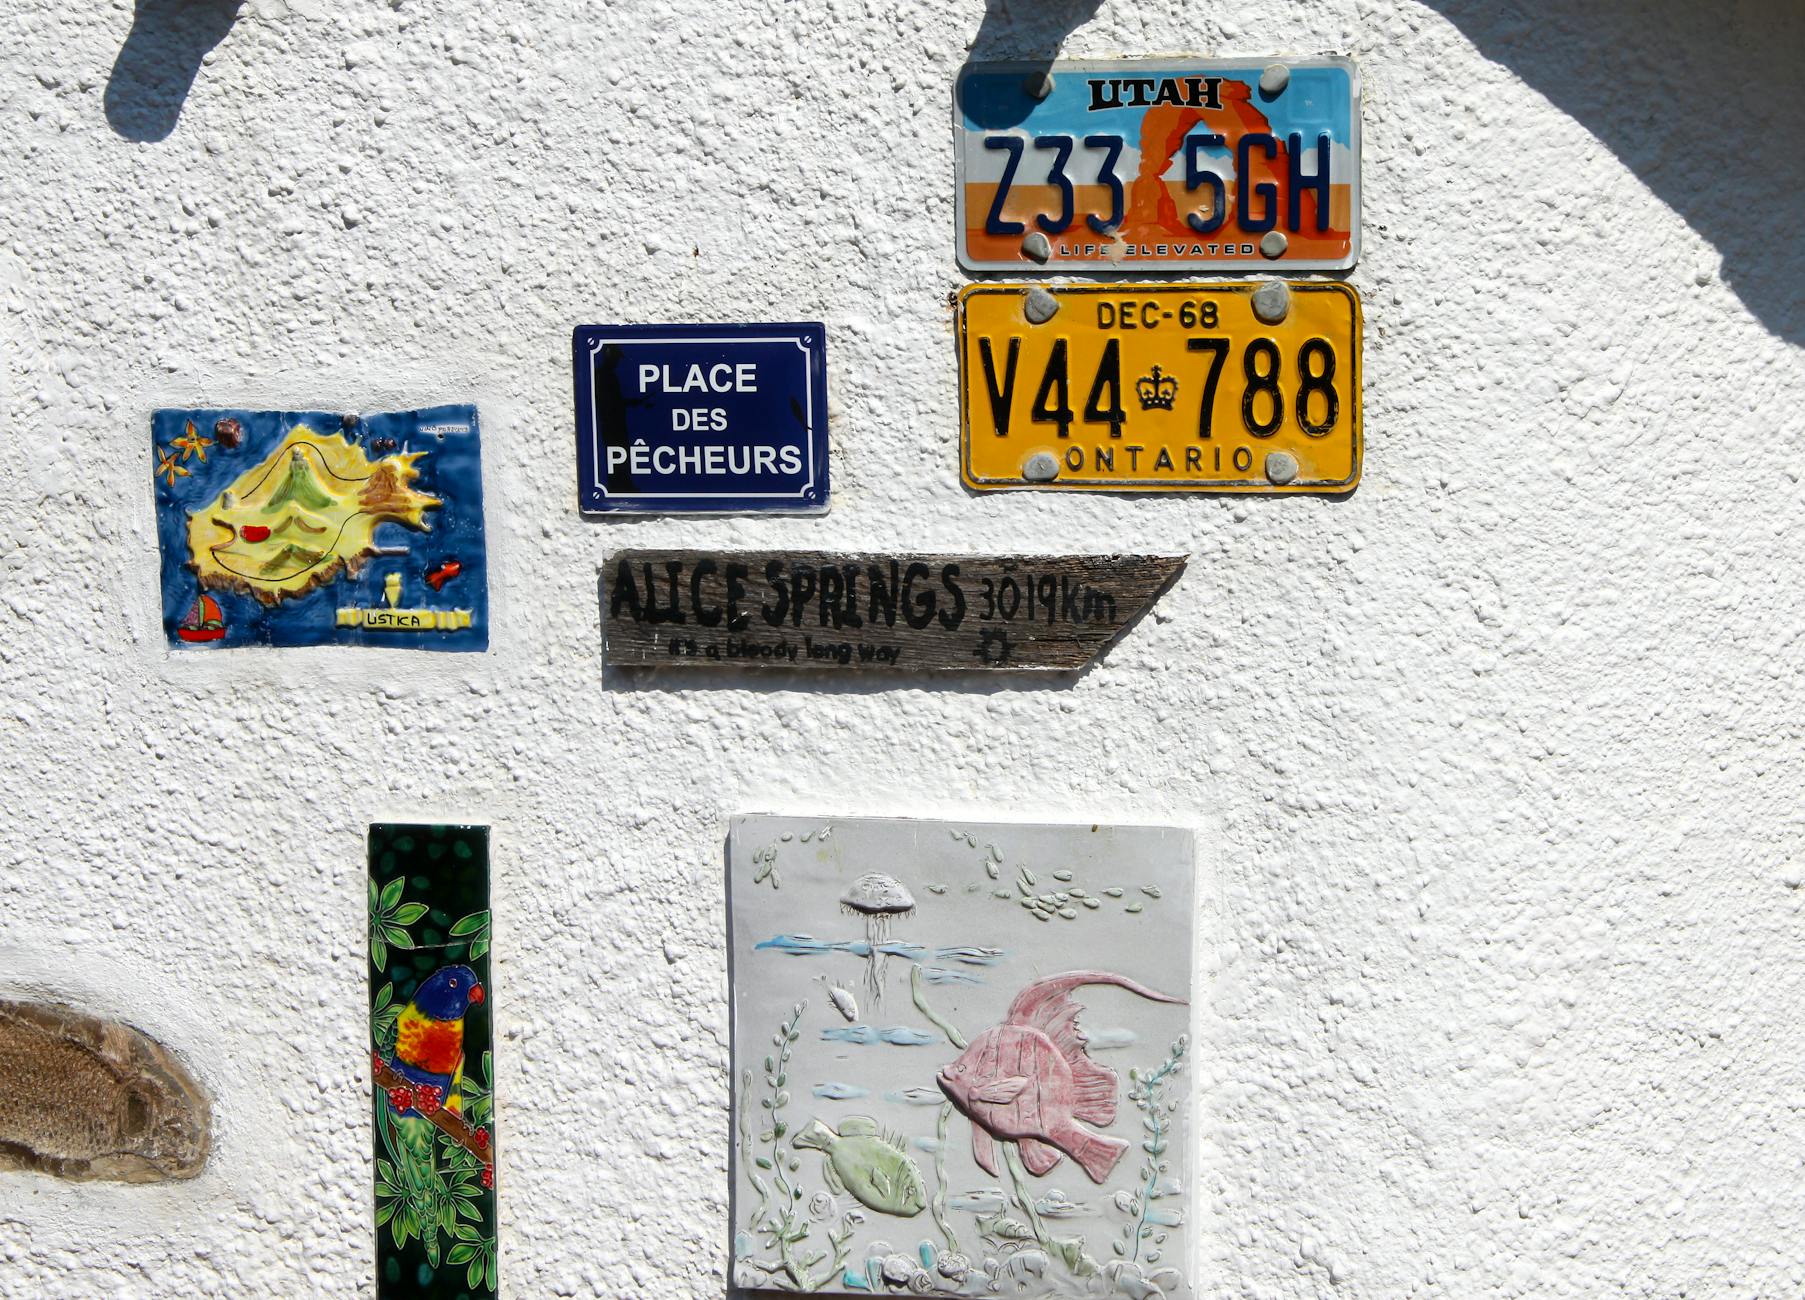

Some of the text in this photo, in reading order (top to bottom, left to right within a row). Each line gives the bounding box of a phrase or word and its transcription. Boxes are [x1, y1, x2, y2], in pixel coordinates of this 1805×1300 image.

[1087, 77, 1223, 111] UTAH
[984, 132, 1332, 236] Z33 5GH
[1060, 244, 1255, 256] LIFE ELEVATED
[1097, 301, 1220, 330] DEC-68
[639, 363, 758, 393] PLACE
[978, 336, 1340, 439] V44 788
[672, 408, 728, 431] DES
[606, 438, 803, 475] PÊCHEURS
[1065, 445, 1254, 472] ONTARIO
[610, 559, 749, 632] ALICE
[761, 559, 967, 631] SPRINGS
[805, 635, 851, 665] long
[858, 643, 900, 665] way
